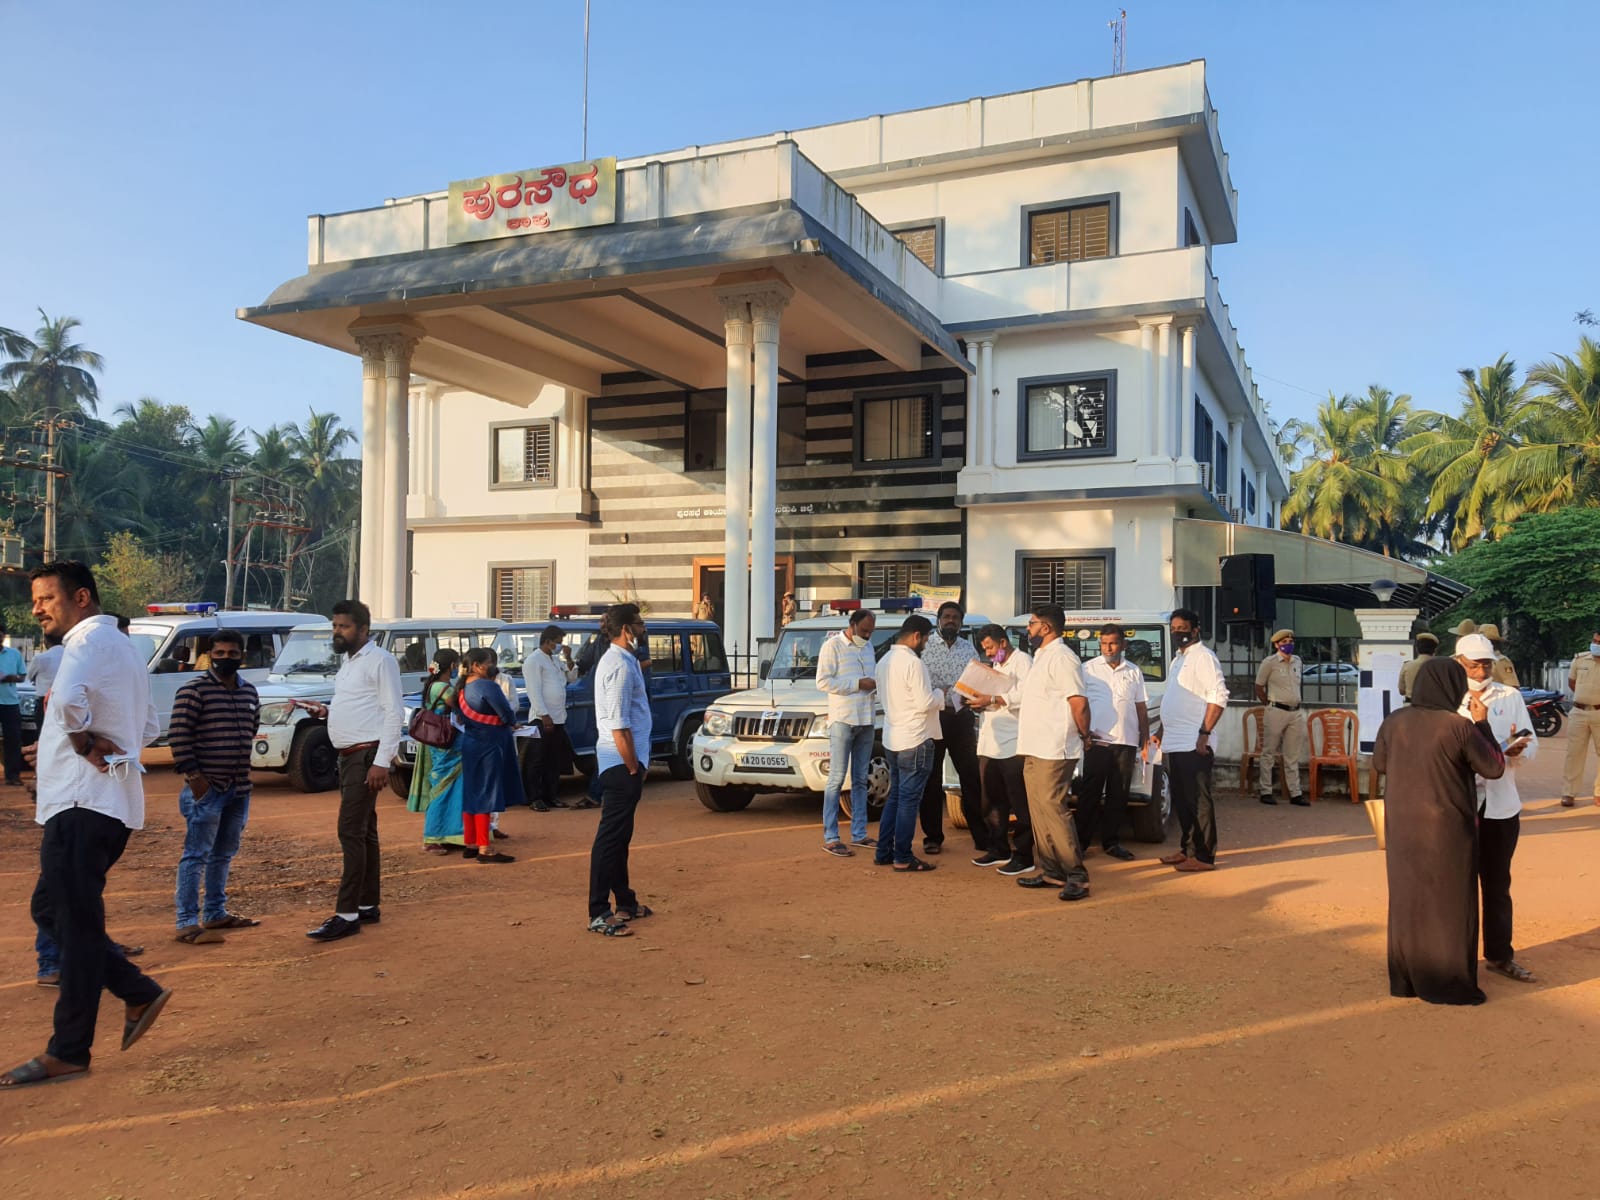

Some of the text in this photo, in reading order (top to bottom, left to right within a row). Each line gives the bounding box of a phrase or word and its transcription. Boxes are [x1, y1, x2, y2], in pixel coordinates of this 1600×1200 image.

[463, 164, 598, 220] ಪುರಸೌಧ
[740, 755, 750, 765] KA
[751, 756, 760, 765] 20
[766, 756, 786, 766] 0565
